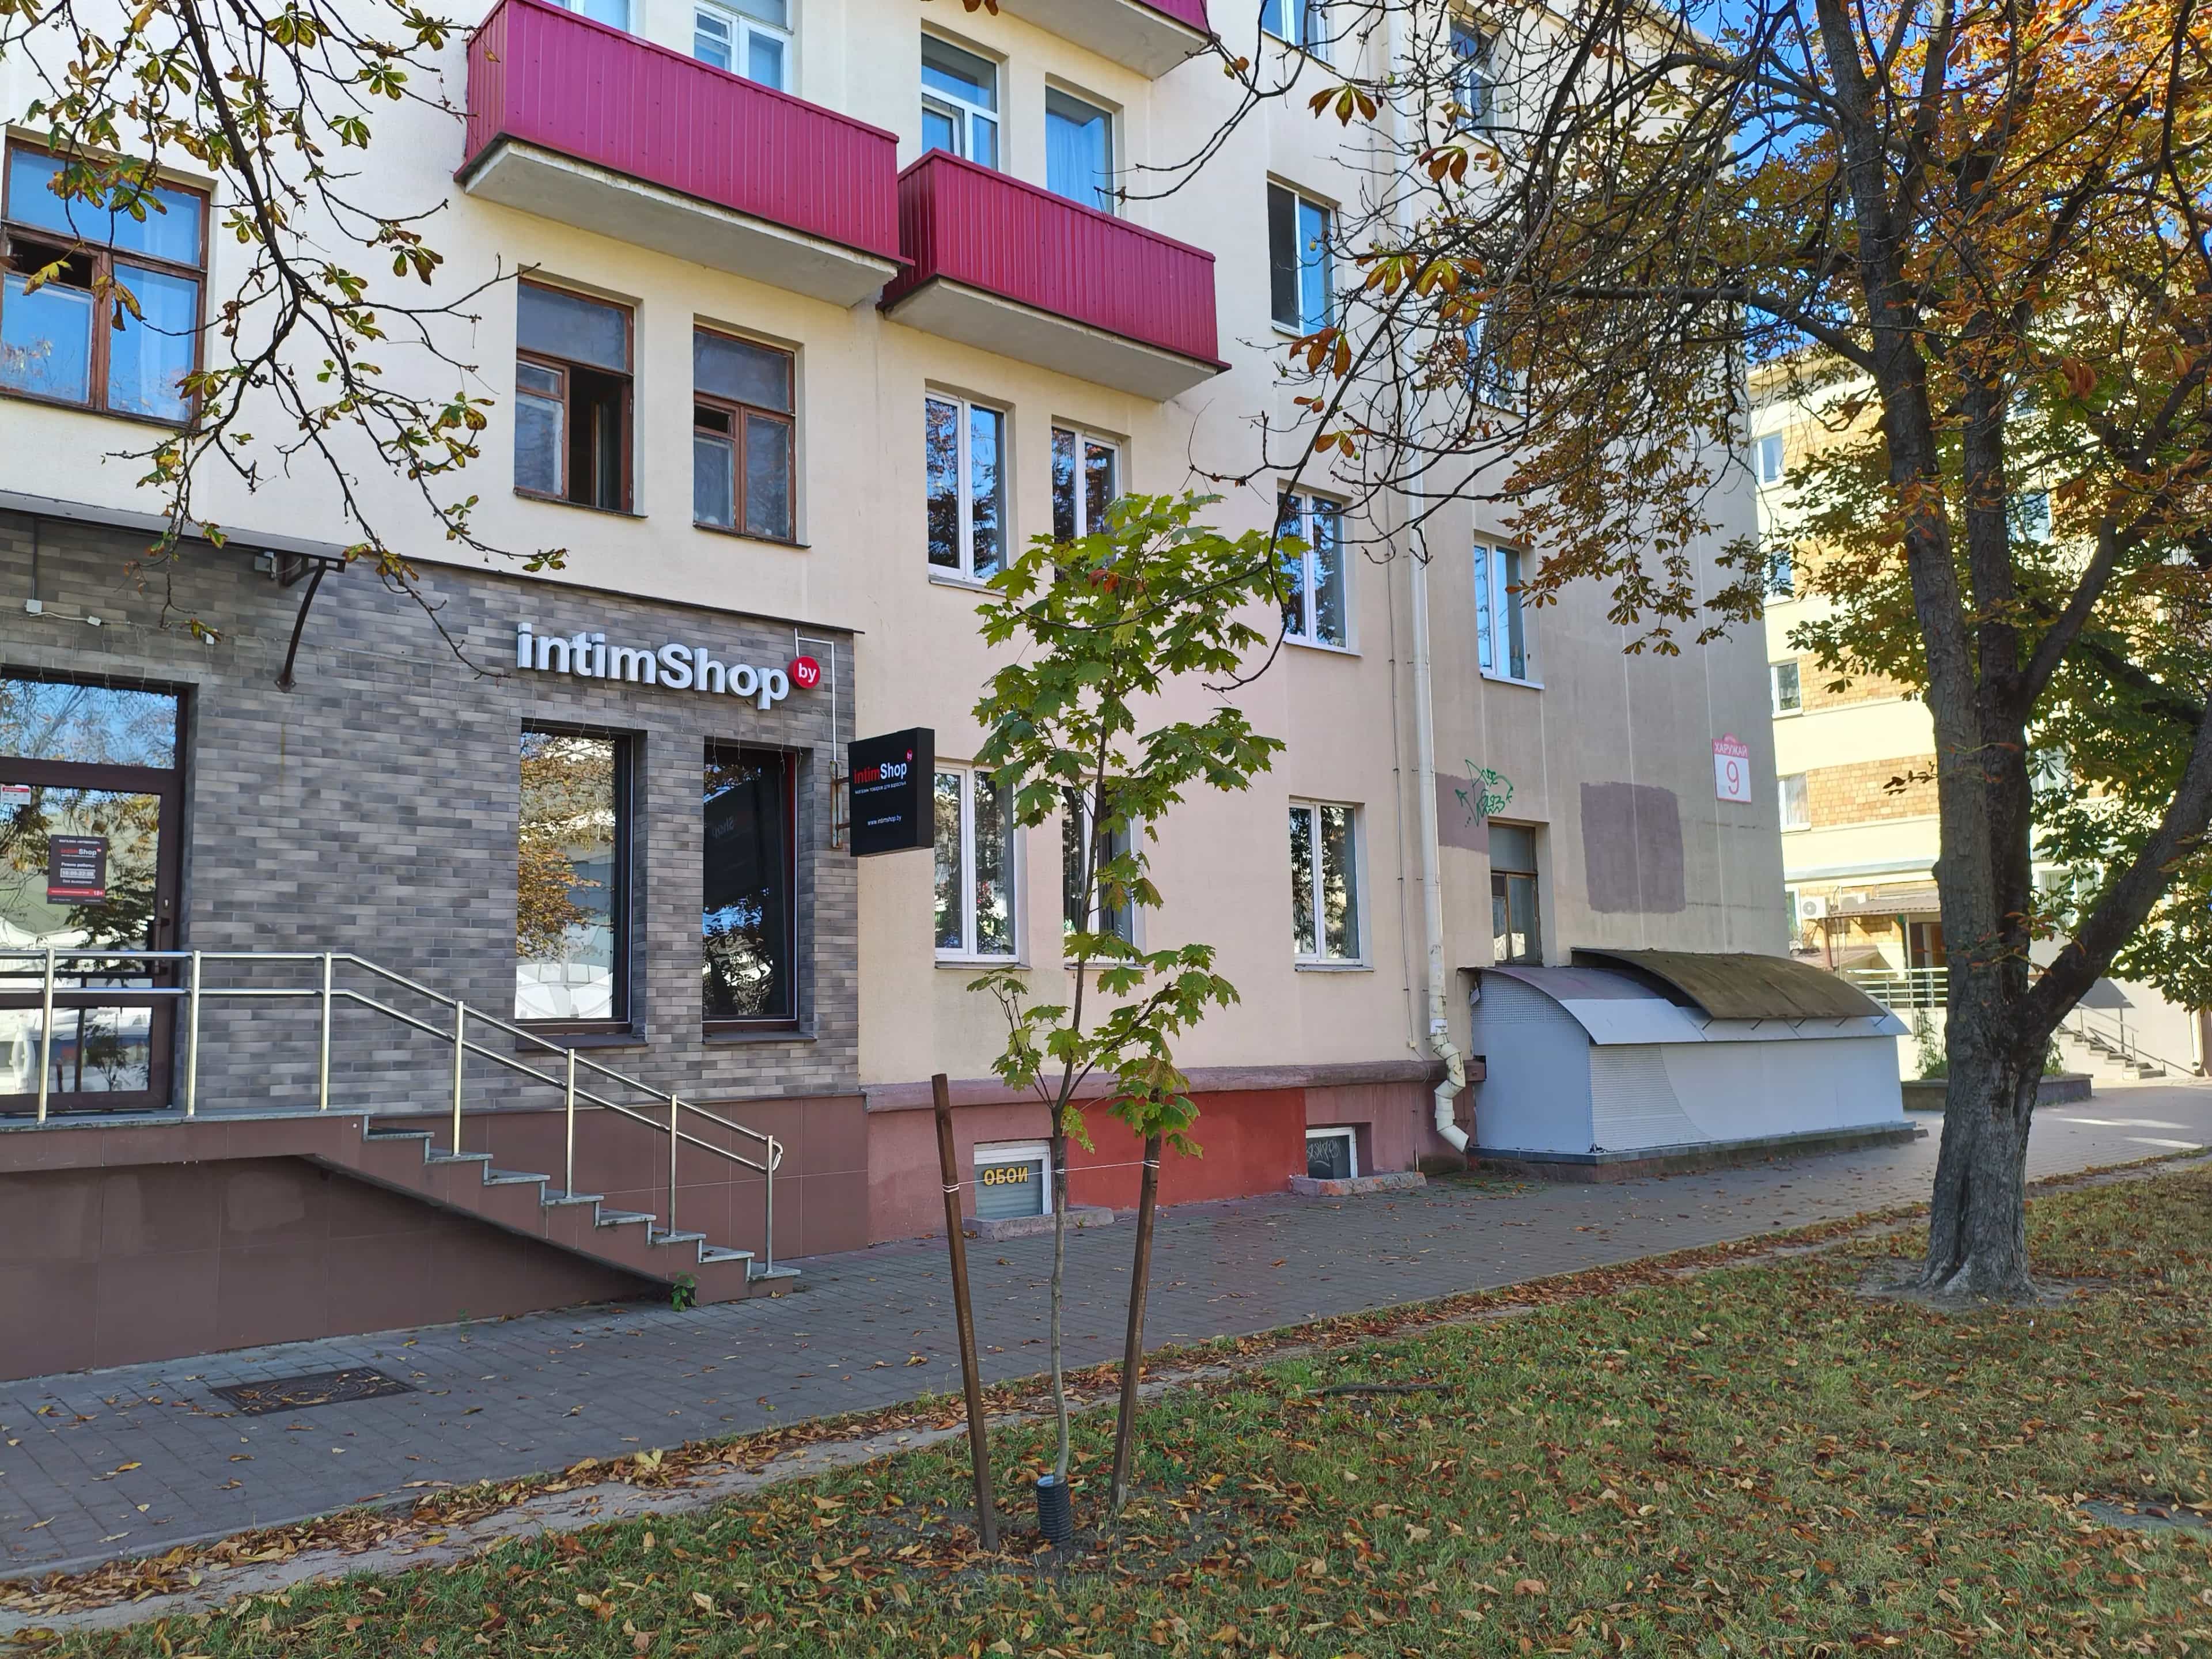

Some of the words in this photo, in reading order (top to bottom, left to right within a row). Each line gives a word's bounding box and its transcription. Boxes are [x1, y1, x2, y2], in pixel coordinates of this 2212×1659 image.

[517, 622, 789, 710] intimShop
[798, 662, 817, 683] by
[1714, 741, 1748, 758] ХАРУЖАЙ
[854, 762, 907, 785] intimShop
[1727, 760, 1739, 795] 9
[984, 1166, 1029, 1186] ОБОИ
